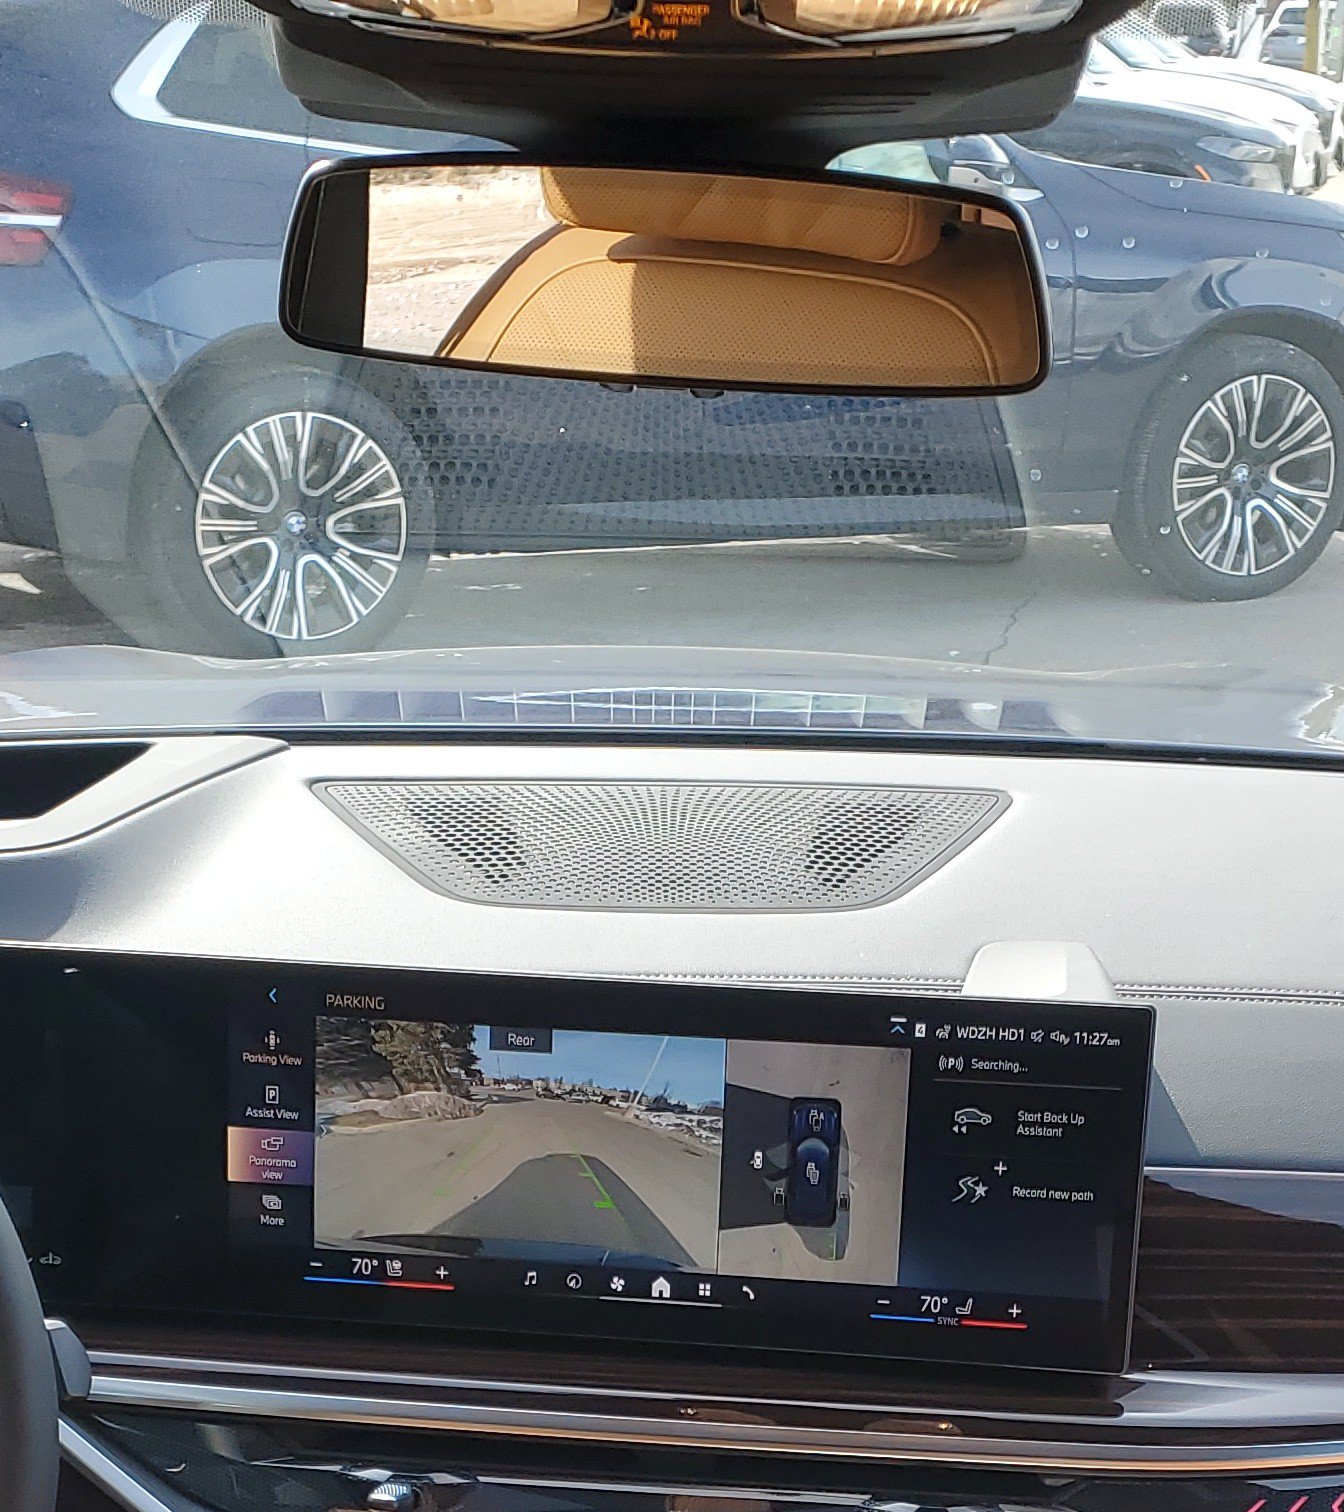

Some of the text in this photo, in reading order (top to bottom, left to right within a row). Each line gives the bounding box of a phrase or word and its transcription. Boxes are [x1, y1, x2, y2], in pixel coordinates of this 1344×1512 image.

[325, 993, 385, 1010] PARKING
[507, 1032, 535, 1047] Rear
[956, 1027, 994, 1041] WDZH
[999, 1028, 1024, 1042] HD1
[242, 1052, 303, 1067] Parking View
[971, 1058, 1028, 1073] Searching...
[245, 1106, 299, 1121] Assist View
[1017, 1110, 1085, 1127] Start Back Up
[1016, 1125, 1063, 1138] Assistant
[249, 1155, 297, 1168] Panorama
[261, 1170, 283, 1181] view
[1012, 1186, 1094, 1203] Record new path
[260, 1214, 285, 1226] More
[351, 1258, 379, 1275] 70°
[920, 1296, 948, 1313] 70°
[937, 1317, 959, 1326] SYNC
